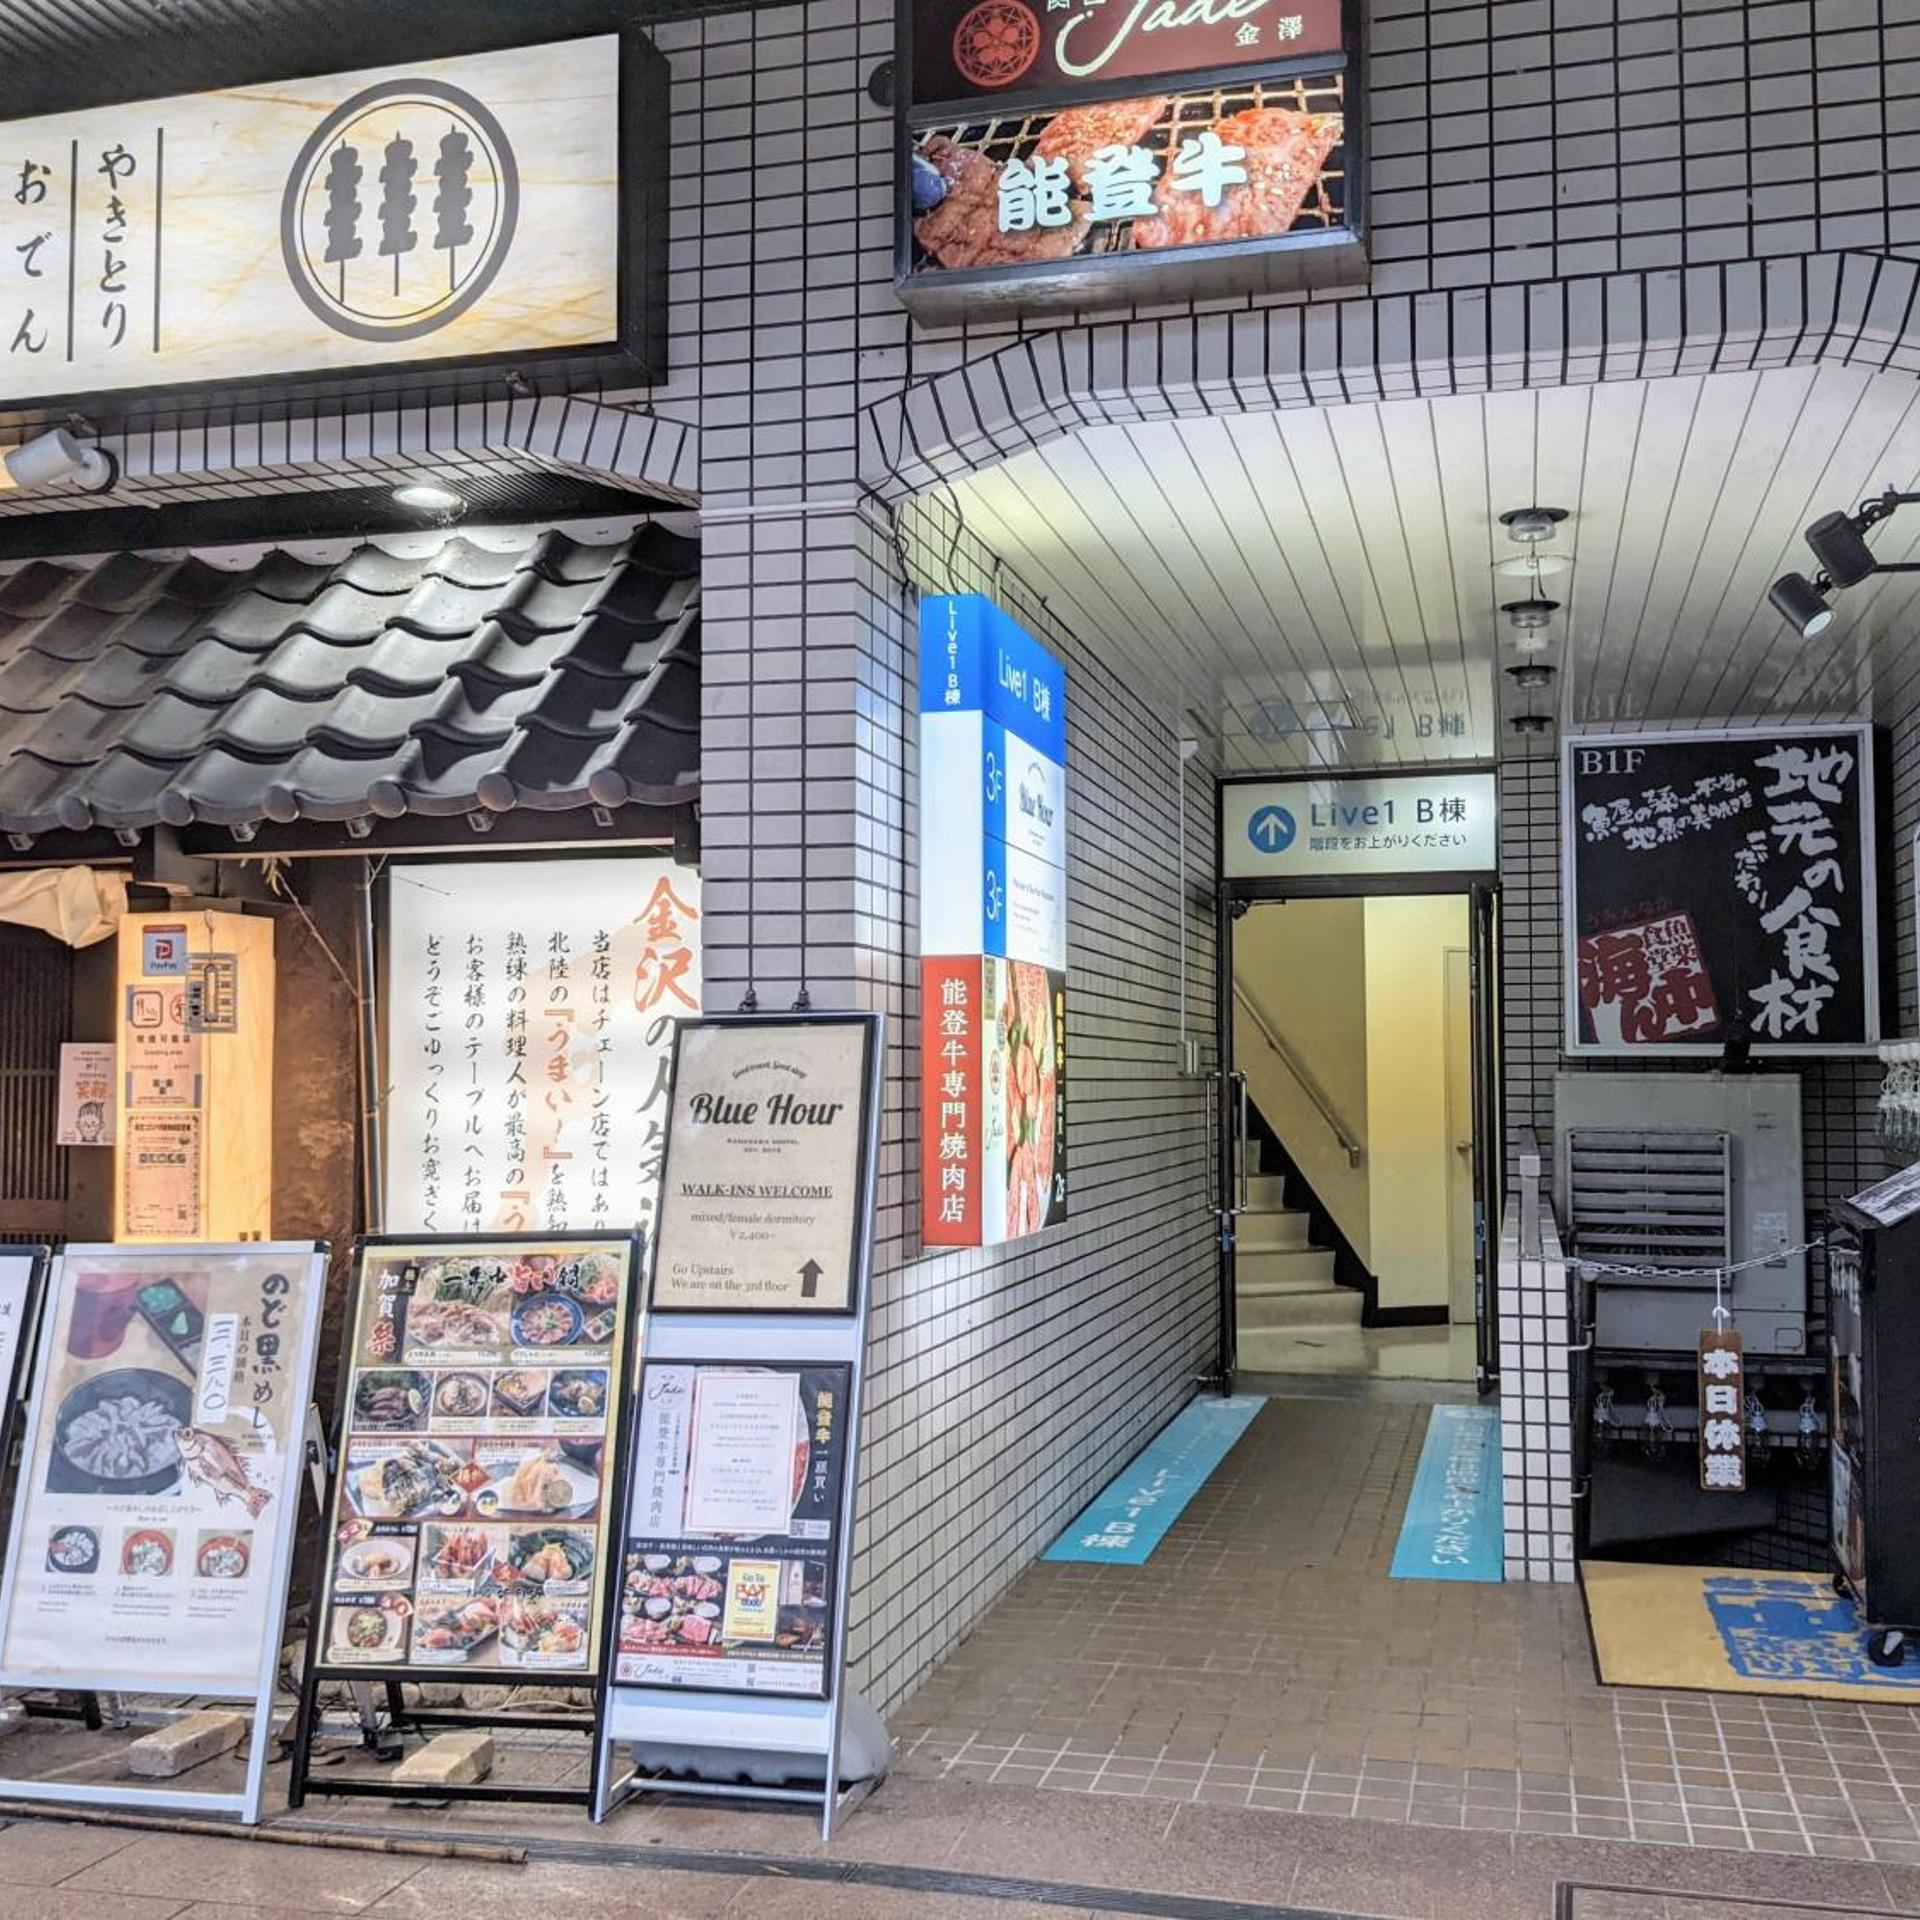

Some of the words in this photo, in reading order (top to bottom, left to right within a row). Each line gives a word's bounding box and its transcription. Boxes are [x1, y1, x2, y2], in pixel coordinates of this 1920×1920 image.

[997, 133, 1247, 233] 能登牛
[11, 159, 51, 355] おでん
[98, 143, 136, 349] やきとり
[999, 648, 1028, 704] Live1
[987, 752, 1002, 803] 3F
[1580, 749, 1646, 775] B1F
[1311, 799, 1395, 827] Live1
[1416, 796, 1466, 824] B棟
[1309, 834, 1467, 851] 階段をお上がりください
[987, 871, 1003, 922] 3F
[1749, 744, 1853, 1039] 地元の食材
[689, 1092, 758, 1125] Blue
[767, 1093, 843, 1126] Hour
[939, 977, 968, 1222] 能登牛専門焼肉店
[681, 1183, 755, 1197] WALK-INS
[758, 1185, 833, 1198] WELCOME
[764, 1212, 815, 1227] dormitory
[671, 1279, 688, 1290] We
[690, 1281, 706, 1290] are
[709, 1282, 722, 1290] on
[725, 1280, 742, 1291] the
[765, 1281, 789, 1292] floor
[672, 1264, 687, 1274] Go
[691, 1264, 734, 1278] Upstairs
[251, 1273, 289, 1429] のど黒めし
